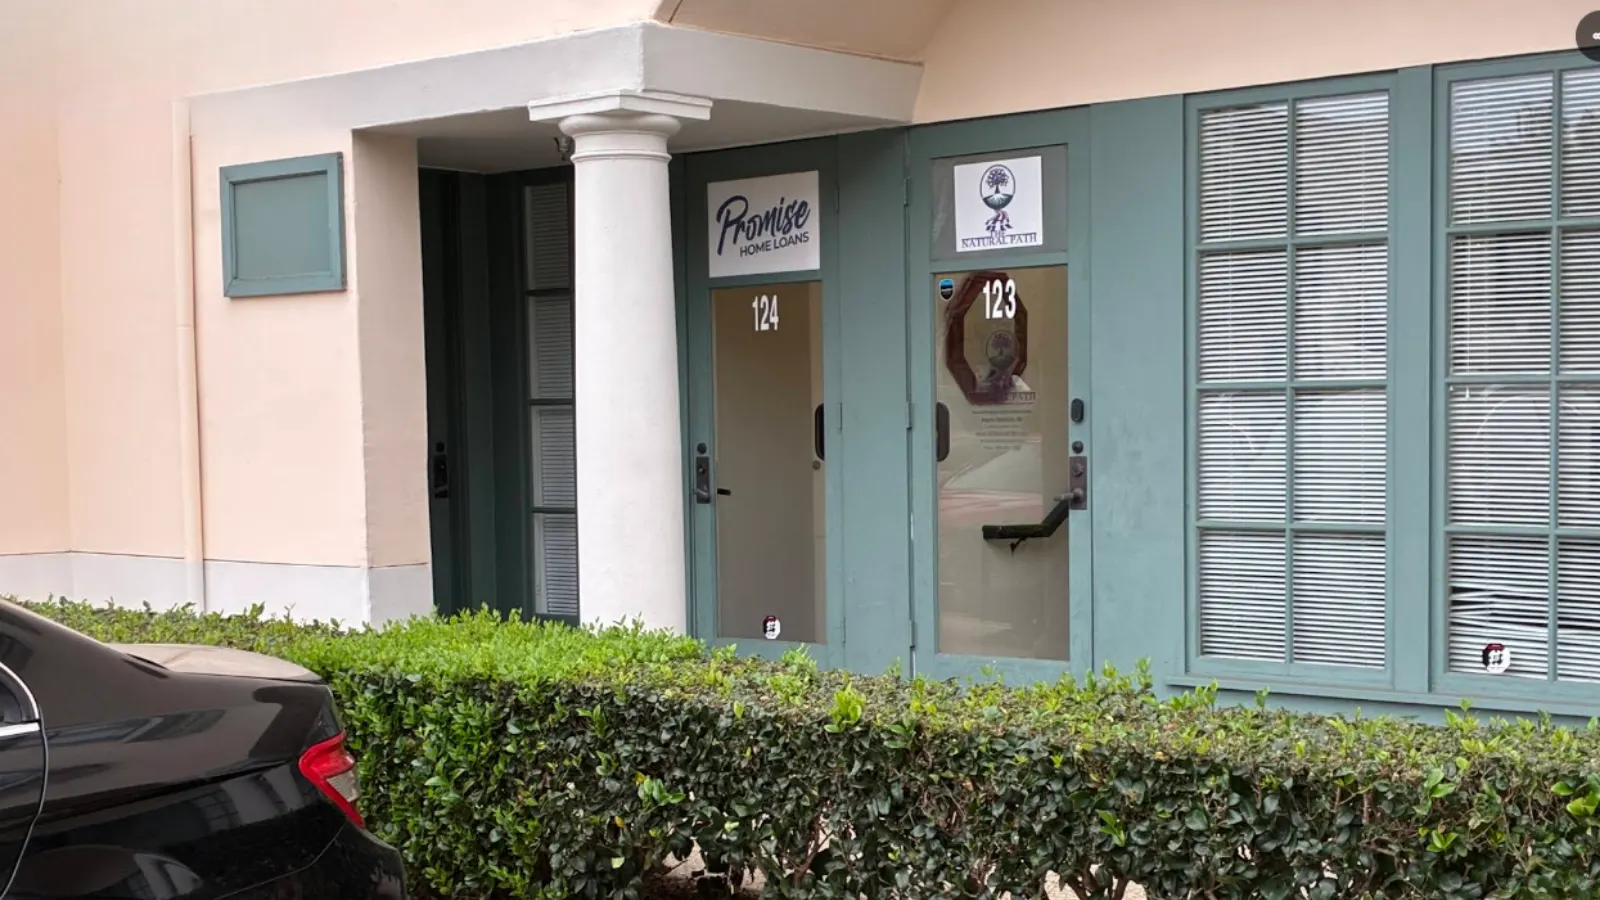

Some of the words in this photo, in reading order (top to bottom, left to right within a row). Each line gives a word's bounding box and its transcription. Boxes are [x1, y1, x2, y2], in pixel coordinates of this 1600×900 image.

[716, 195, 811, 256] Promise
[740, 240, 771, 257] HOME
[774, 231, 809, 249] LOANS
[961, 236, 1009, 248] NATURAL
[1009, 232, 1037, 243] PATH
[752, 294, 779, 331] 124
[983, 279, 1016, 319] 123
